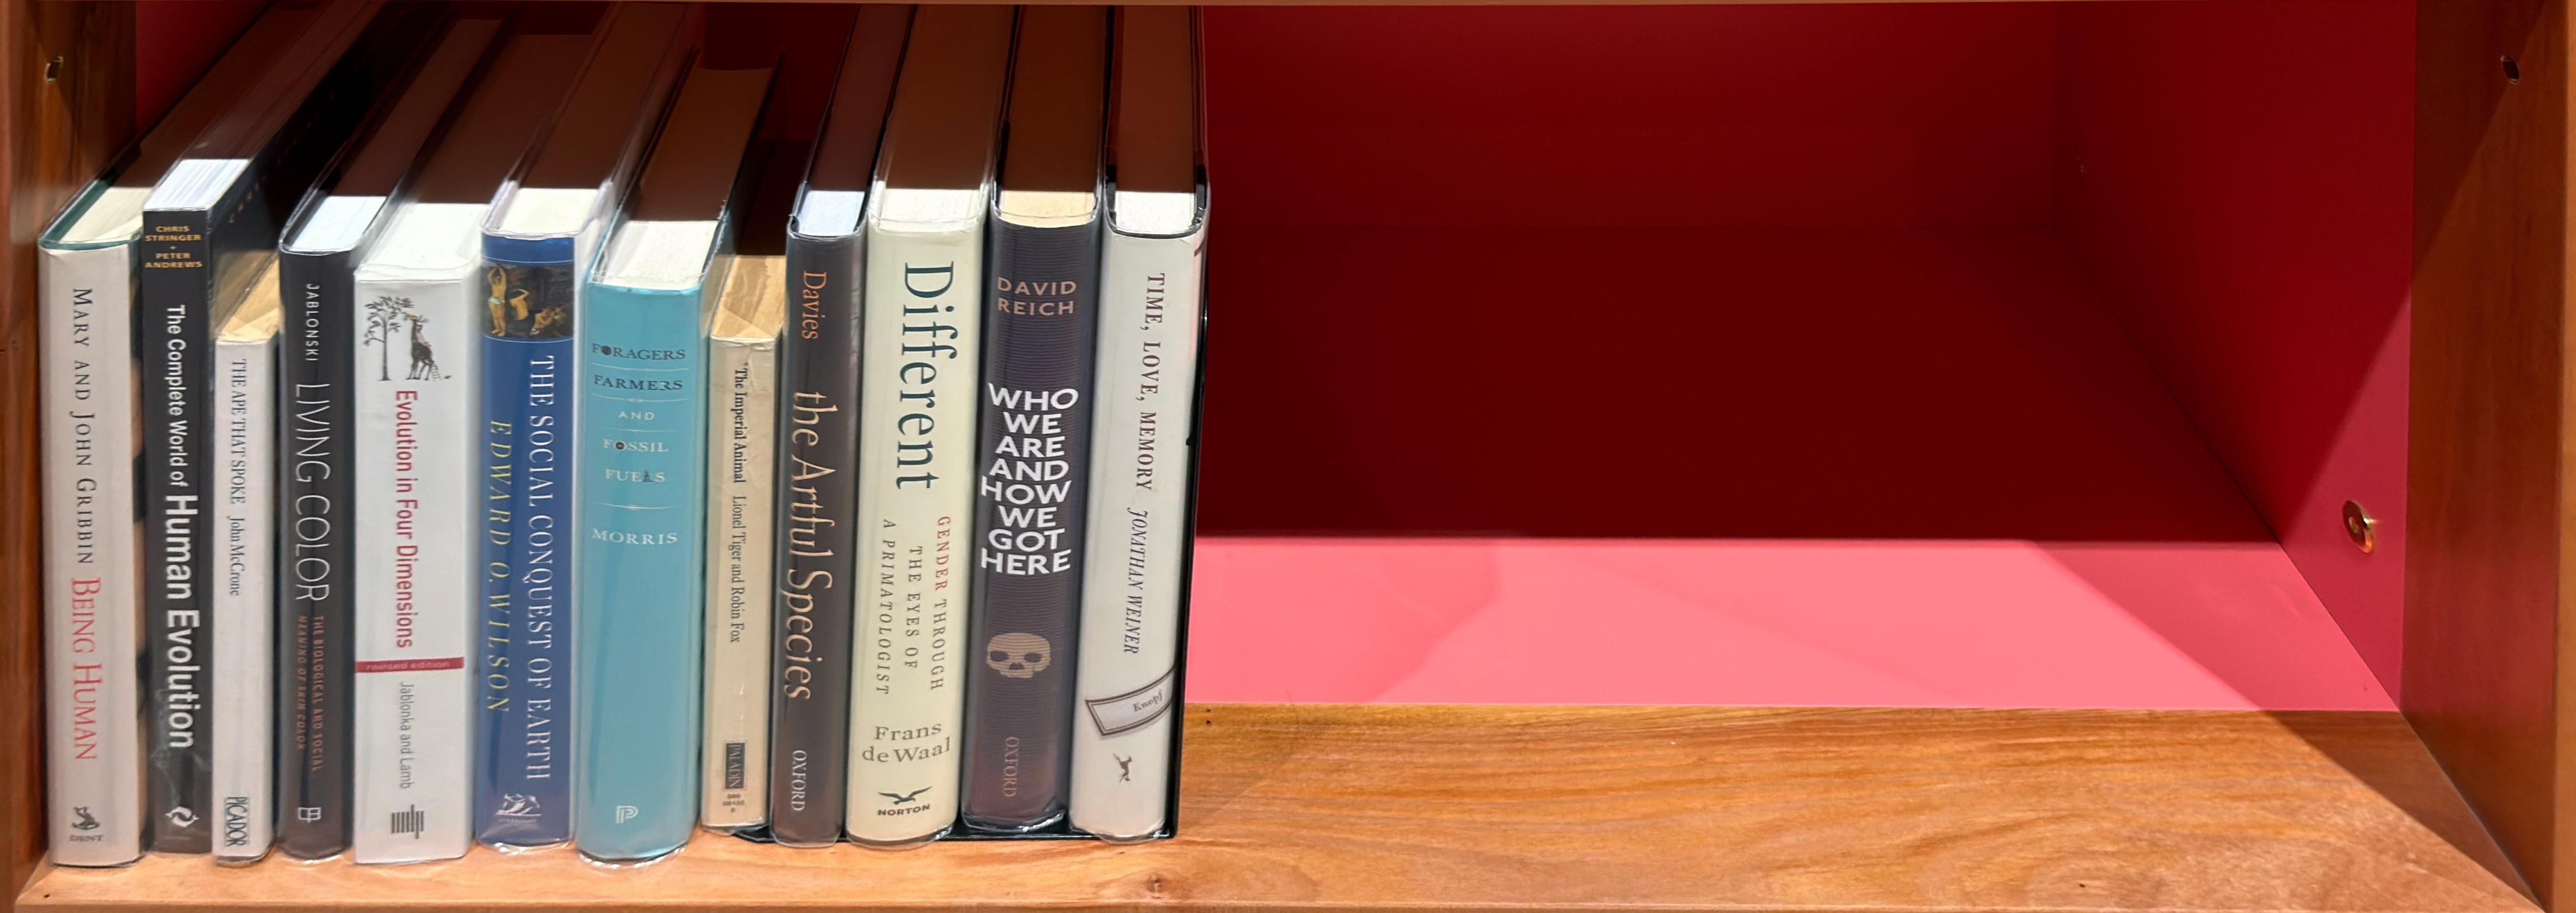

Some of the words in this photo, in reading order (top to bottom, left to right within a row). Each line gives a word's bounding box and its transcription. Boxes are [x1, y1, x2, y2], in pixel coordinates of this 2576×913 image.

[802, 271, 827, 339] Davies
[997, 276, 1076, 295] DAVID
[997, 297, 1074, 316] REICH
[1140, 273, 1165, 331] TIME,
[73, 288, 92, 346] MARY
[166, 305, 185, 334] The
[306, 284, 320, 361] JABLONSKI
[232, 358, 246, 386] THE
[592, 343, 686, 360] FORAGERS
[1135, 341, 1161, 401] LOVE,
[74, 361, 89, 400] AND
[164, 338, 187, 416] Complete
[530, 355, 554, 406] THE
[594, 375, 683, 390] FARMERS
[734, 368, 748, 389] The
[896, 261, 958, 489] Different
[231, 390, 245, 416] APE
[618, 411, 655, 420] AND
[731, 392, 748, 440] Imperial
[988, 383, 1078, 411] WHO
[69, 411, 96, 465] JOHN
[231, 417, 246, 457] THAT
[295, 384, 331, 482] LIVING
[396, 391, 418, 471] Evolution
[792, 392, 838, 446] the
[1003, 411, 1061, 434] WE
[167, 420, 188, 467] World
[529, 416, 554, 507] SOCIAL
[603, 439, 670, 452] FOSSIL
[733, 442, 747, 484] Animal
[995, 436, 1065, 457] ARE
[1136, 411, 1157, 490] MEMORY
[171, 470, 188, 487] of
[231, 460, 246, 504] SPOKE
[396, 476, 417, 492] in
[489, 421, 512, 546] EDWARD
[981, 476, 1072, 504] HOW
[989, 458, 1069, 481] AND
[77, 479, 97, 563] GRIBBIN
[396, 500, 418, 537] Four
[732, 497, 746, 530] Lionel
[789, 454, 836, 556] Artful
[883, 519, 896, 529] A
[998, 505, 1056, 528] WE
[165, 496, 199, 599] Human
[227, 516, 245, 542] John
[295, 495, 330, 601] COLOR
[591, 529, 677, 545] MORRIS
[728, 531, 746, 564] Tiger
[988, 529, 1065, 552] GOT
[1127, 507, 1148, 590] JONATHAN
[230, 545, 245, 596] McCrone
[489, 563, 511, 582] O.
[732, 564, 746, 583] and
[908, 546, 923, 583] THE
[935, 517, 951, 591] GENDER
[981, 548, 1072, 576] HERE
[396, 546, 418, 649] Dimensions
[522, 516, 553, 649] CONQUEST
[732, 587, 745, 619] Robin
[72, 577, 101, 652] BEING
[730, 623, 745, 643] Fox
[781, 569, 833, 699] Species
[876, 539, 896, 694] PRIMATOLOGIST
[906, 593, 921, 638] EYES
[1124, 595, 1143, 654] WEINER
[487, 595, 511, 712] WILSON
[904, 647, 919, 668] OF
[931, 599, 947, 690] THROUGH
[167, 610, 200, 747] Evolution
[528, 657, 552, 689] OF
[73, 664, 103, 760] HUMAN
[400, 682, 415, 731] Jablonka
[1132, 689, 1164, 713] Knopf
[400, 735, 415, 755] and
[526, 700, 551, 779] EARTH
[862, 746, 889, 763] de
[894, 738, 950, 761] Waal
[875, 723, 942, 741] Frans
[400, 758, 415, 789] Lamb
[790, 750, 807, 811] OXFORD
[1004, 736, 1020, 797] OXFORD
[225, 796, 248, 847] PICADOR
[877, 804, 931, 816] NORTON
